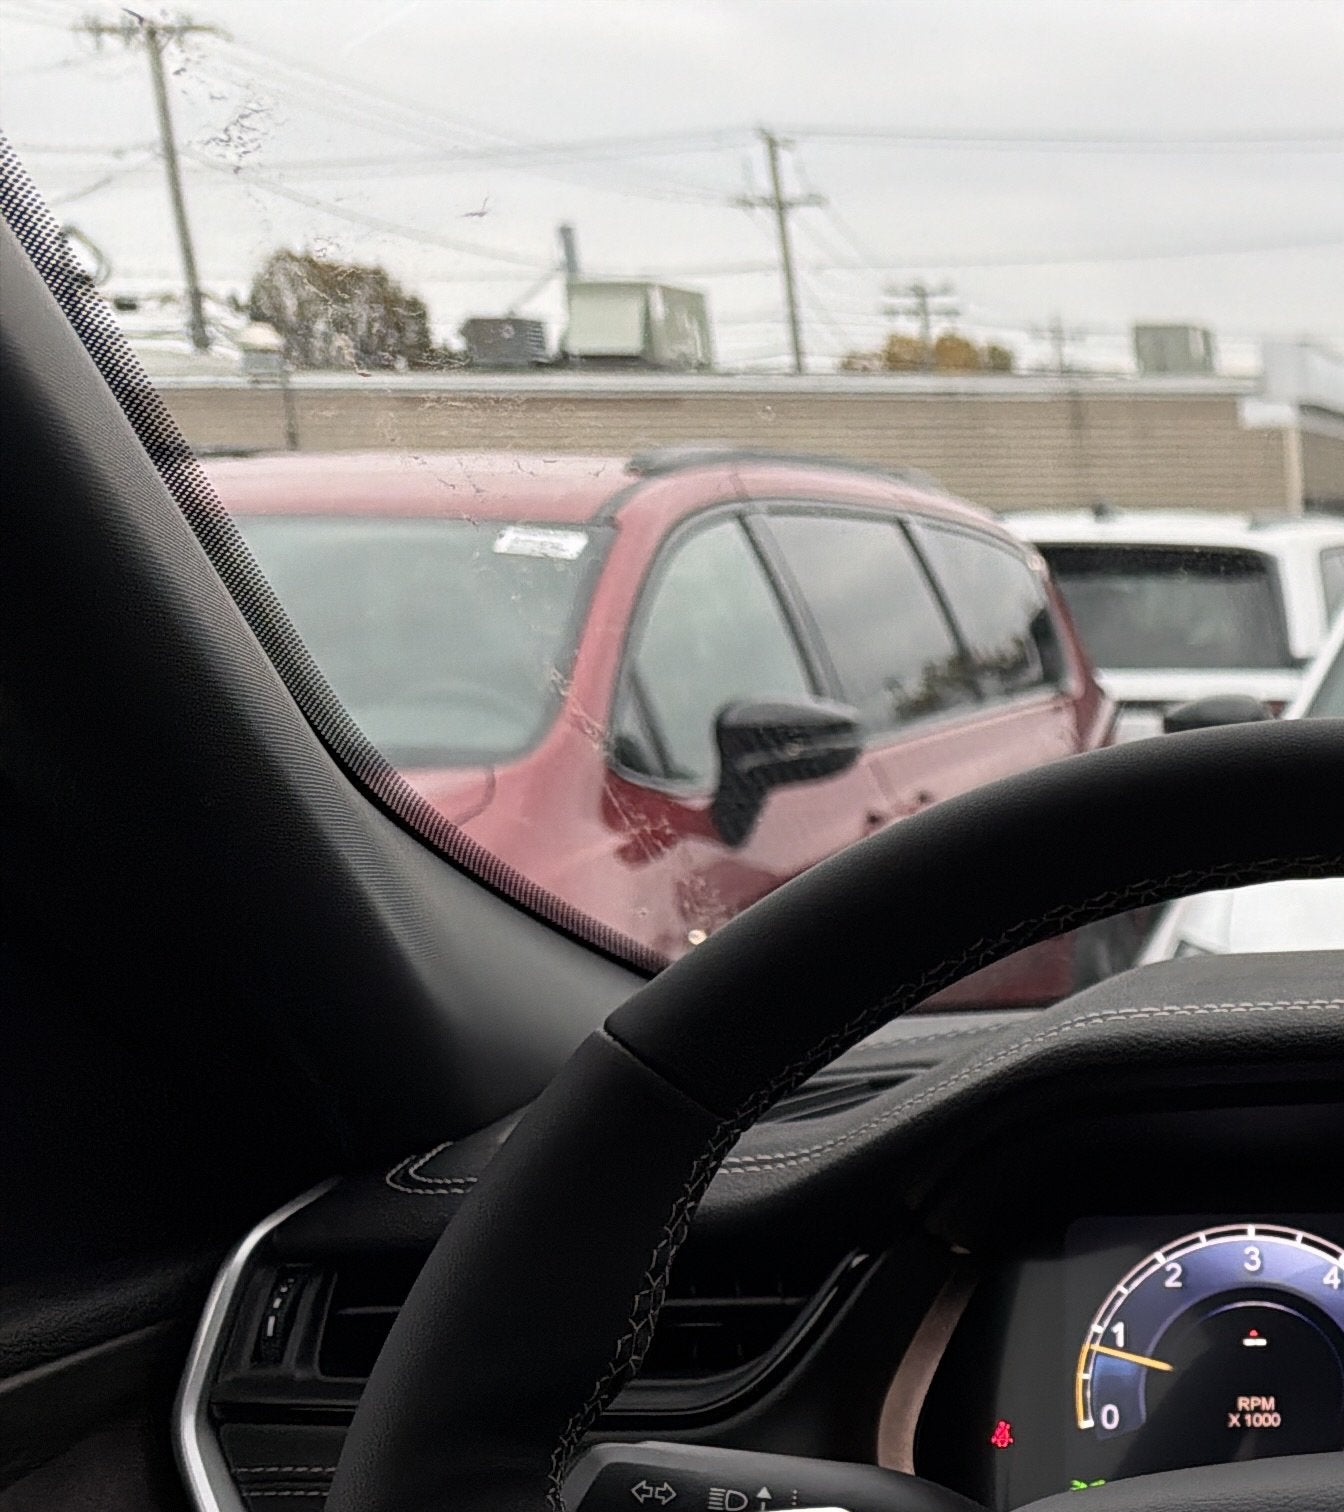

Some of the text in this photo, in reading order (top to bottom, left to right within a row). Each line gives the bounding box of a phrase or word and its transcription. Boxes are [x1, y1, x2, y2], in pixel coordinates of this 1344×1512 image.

[1243, 1246, 1262, 1272] 3
[1164, 1263, 1183, 1288] 2
[1322, 1265, 1341, 1290] 4
[1110, 1321, 1125, 1348] 1
[1236, 1396, 1276, 1412] RPM
[1100, 1404, 1119, 1430] 0
[1228, 1412, 1281, 1428] X 1000
